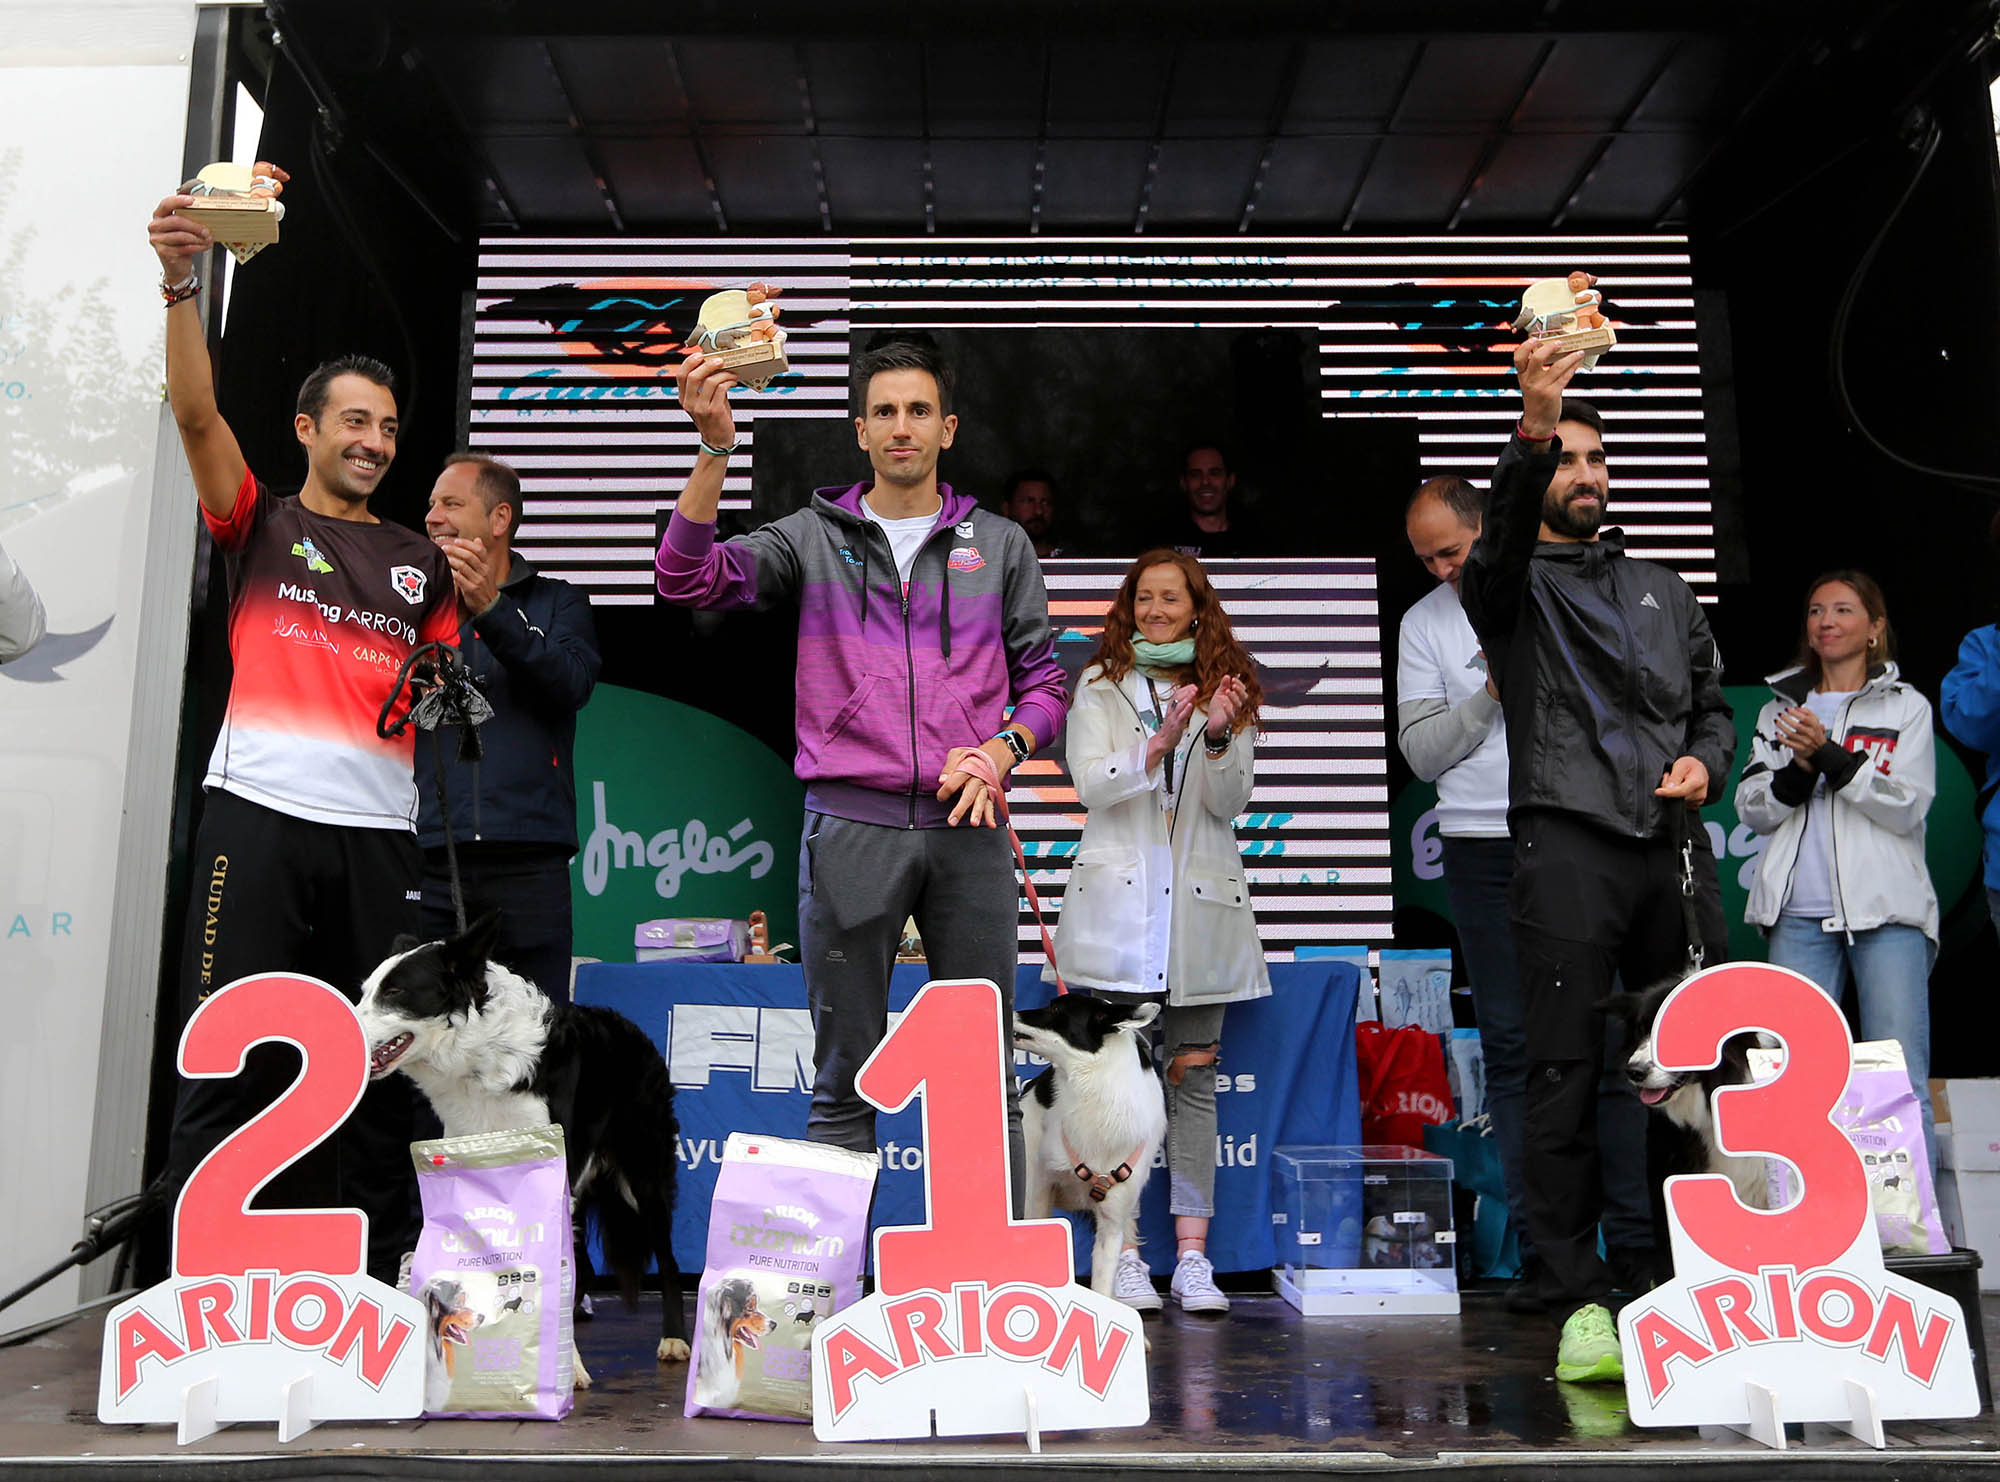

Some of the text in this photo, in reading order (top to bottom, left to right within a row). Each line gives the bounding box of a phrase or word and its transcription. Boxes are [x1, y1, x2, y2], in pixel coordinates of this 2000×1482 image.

[353, 646, 391, 668] CARPE
[582, 780, 774, 899] Inglés
[203, 854, 229, 946] CIUDAD
[200, 951, 214, 985] DE
[178, 975, 368, 1276] 2
[858, 983, 1071, 1291] 1
[1655, 964, 1869, 1273] 3
[457, 1256, 481, 1268] PURE
[749, 1254, 820, 1273] PURE NUTRITION
[764, 1204, 820, 1229] ARION
[115, 1272, 414, 1404] ARION
[822, 1285, 1132, 1424] ARION
[1631, 1269, 1953, 1408] ARION
